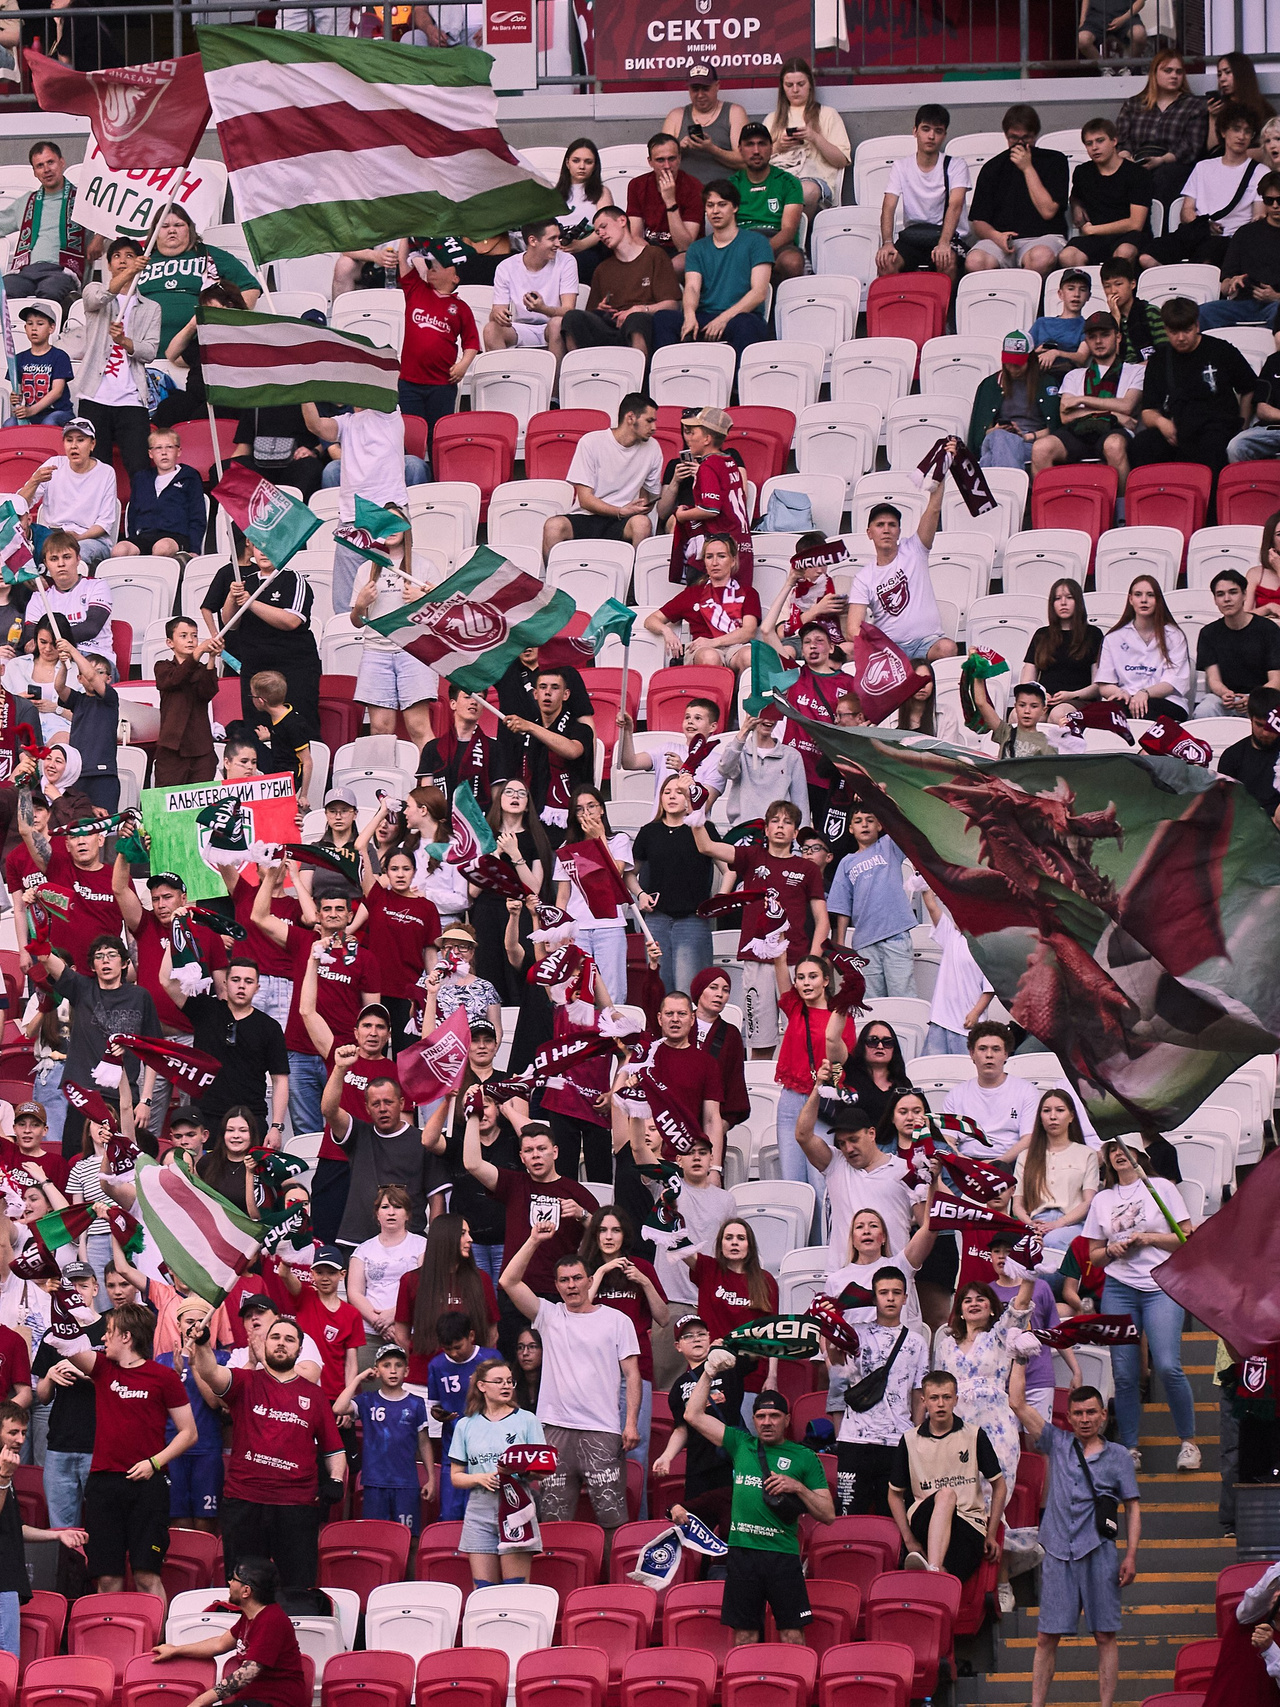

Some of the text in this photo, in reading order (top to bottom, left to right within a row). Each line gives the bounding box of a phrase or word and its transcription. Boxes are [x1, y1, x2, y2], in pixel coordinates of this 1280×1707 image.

[647, 17, 761, 42] СЕКТОР
[687, 43, 717, 52] ИМЕНИ
[624, 56, 695, 71] ВИКТОРА
[84, 174, 155, 227] АЛГА
[411, 307, 452, 335] Carlsberg
[260, 780, 293, 800] РУБИН
[52, 1321, 80, 1335] 1958
[441, 1374, 462, 1394] 13
[370, 1406, 387, 1422] 16
